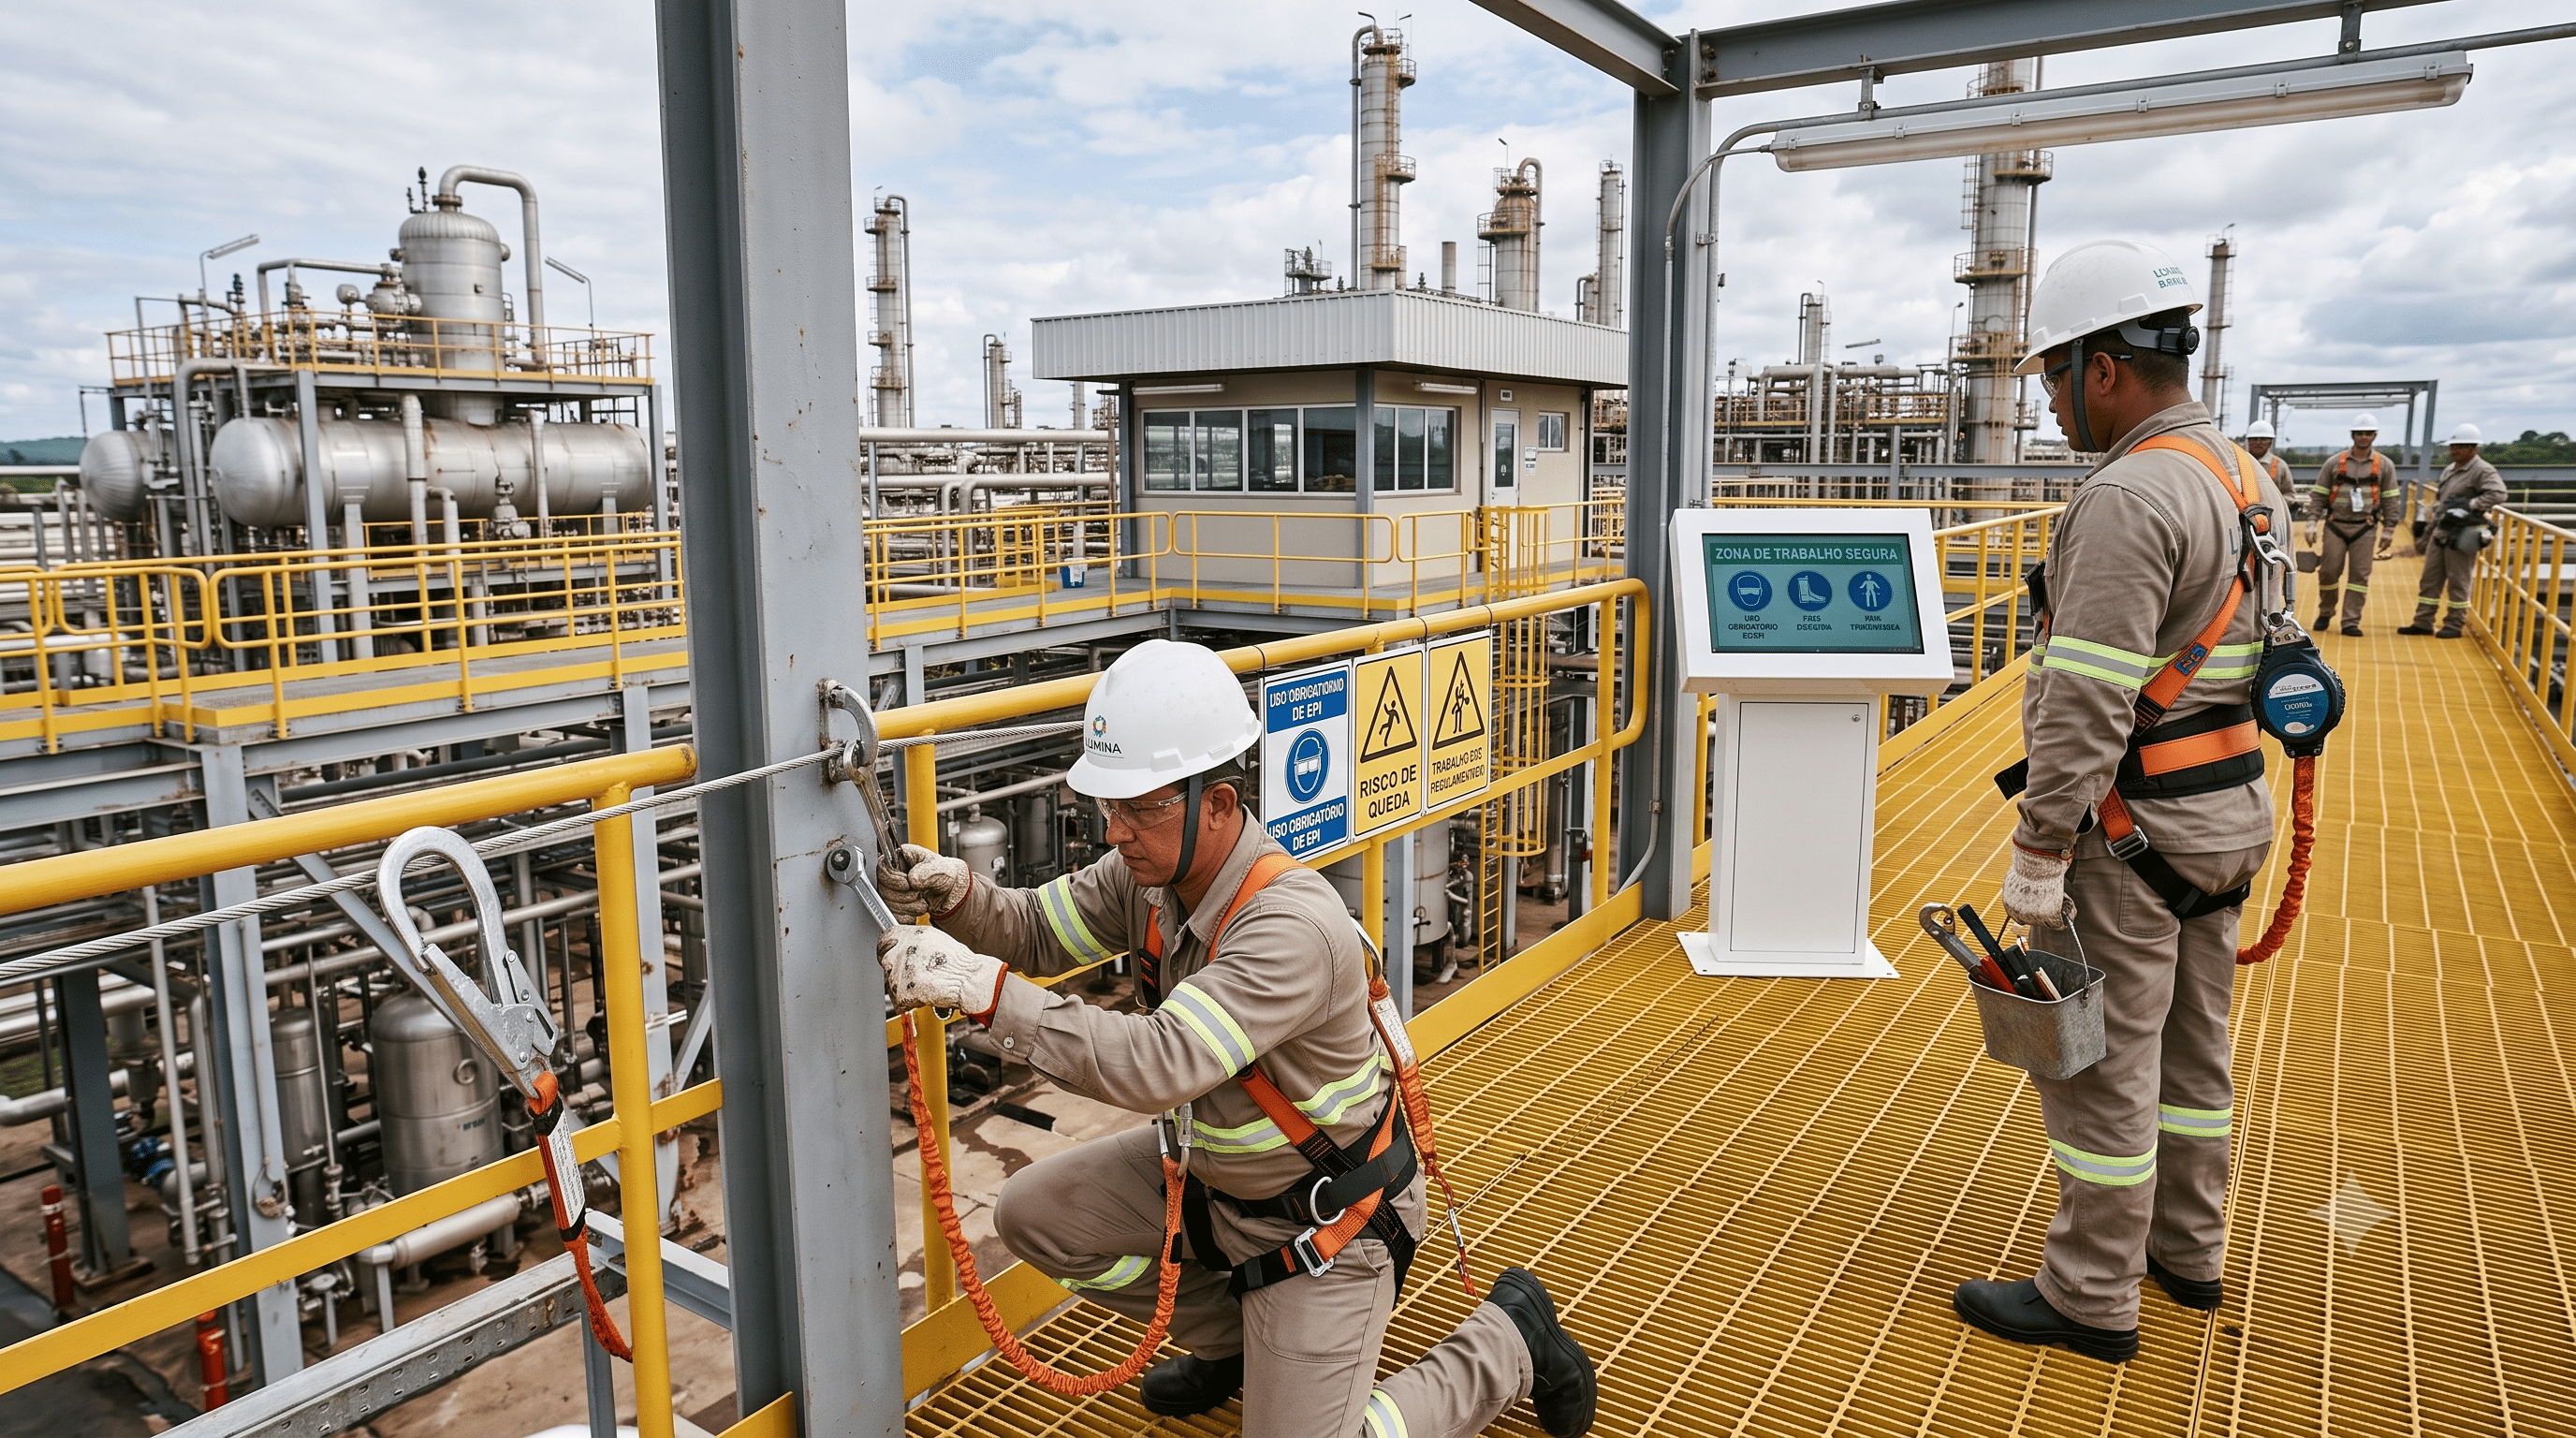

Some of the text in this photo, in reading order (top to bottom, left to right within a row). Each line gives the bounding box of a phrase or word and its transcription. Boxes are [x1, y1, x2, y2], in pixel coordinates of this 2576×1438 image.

[1716, 548, 1898, 561] ZONA DE TRABALHO SEGURA
[1292, 700, 1322, 722] DE EPI
[1359, 764, 1417, 799] RISCO DE
[1368, 790, 1411, 819] QUEDA
[1268, 822, 1287, 839] USO
[1292, 828, 1321, 852] DE EPI
